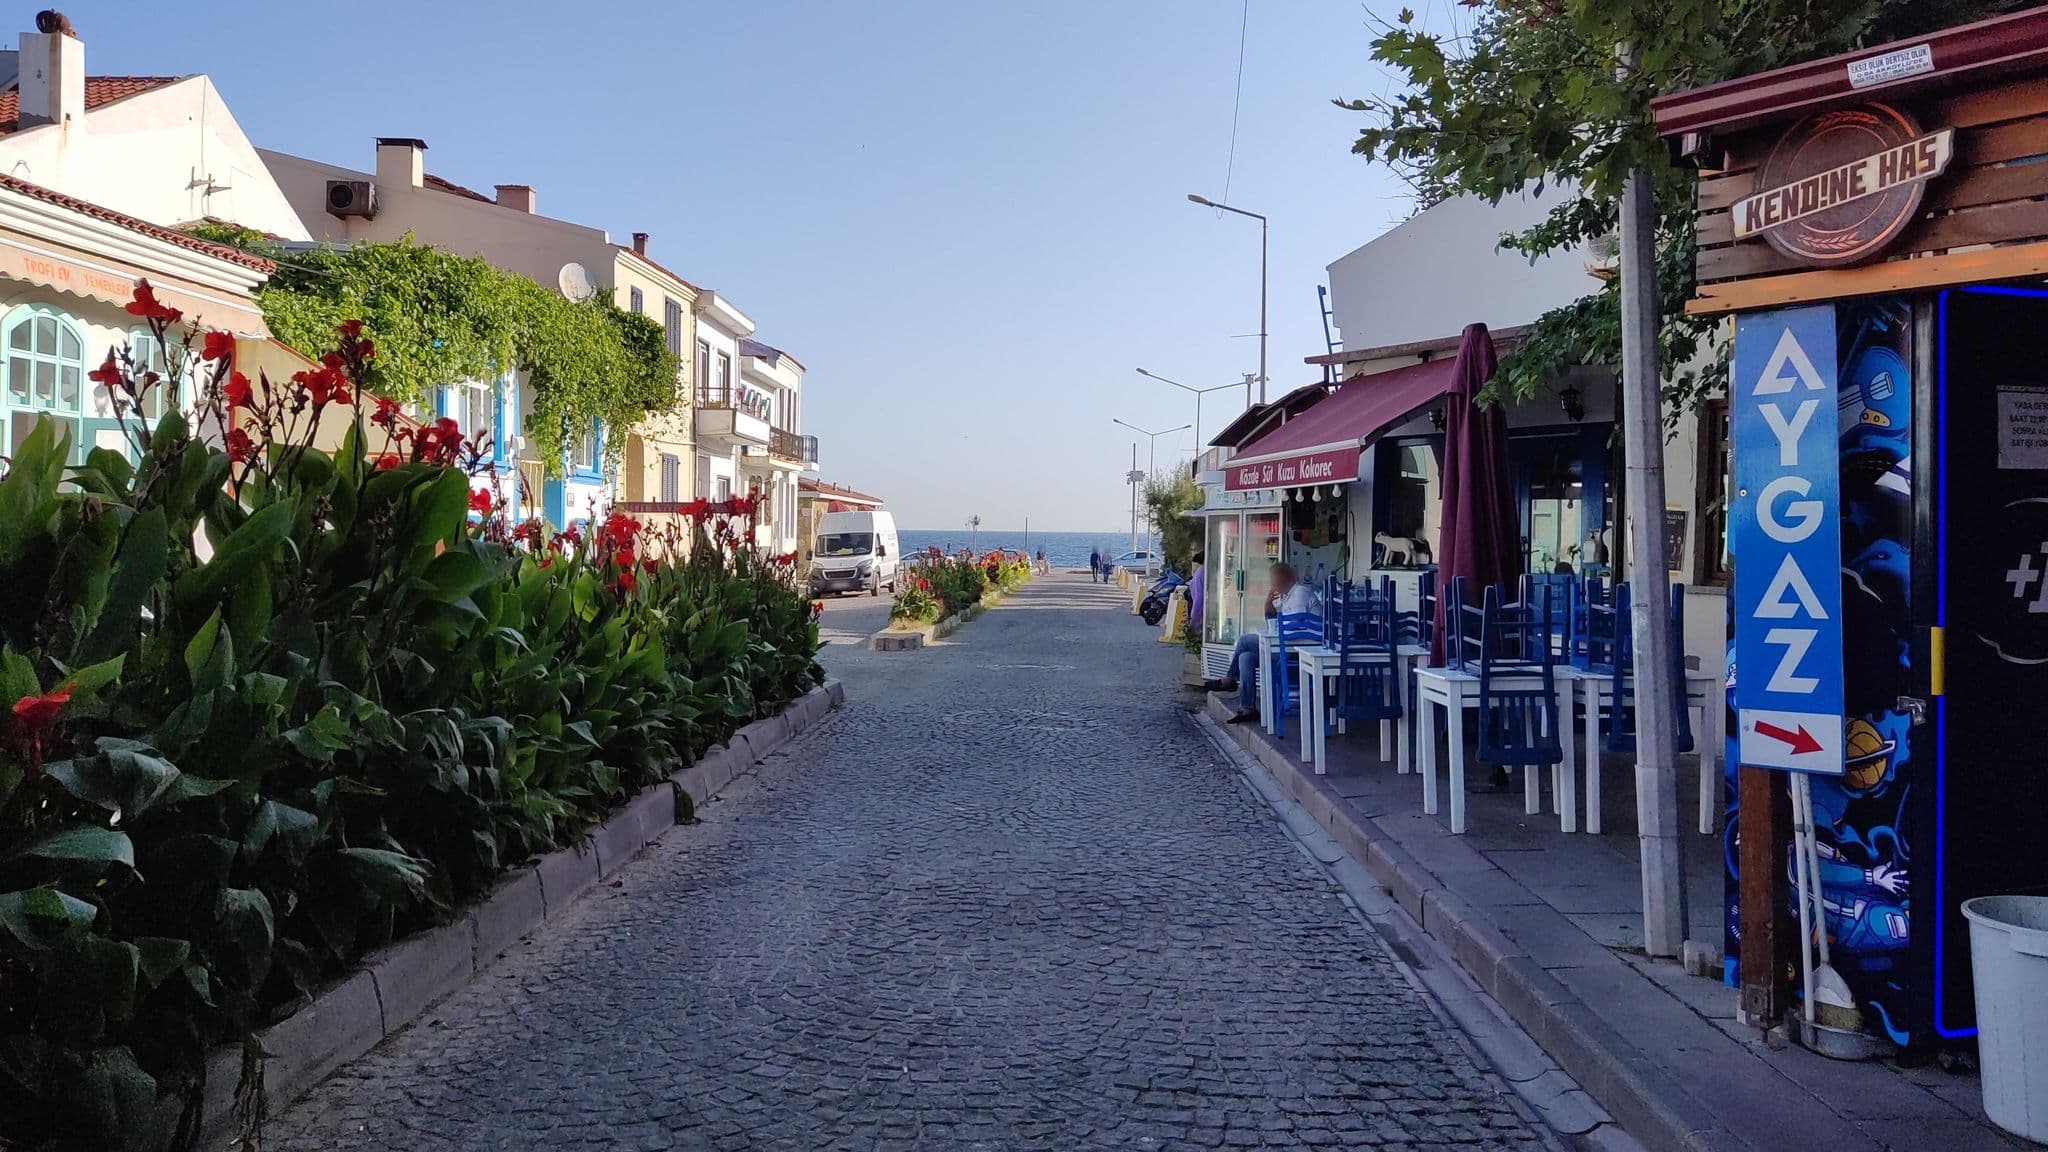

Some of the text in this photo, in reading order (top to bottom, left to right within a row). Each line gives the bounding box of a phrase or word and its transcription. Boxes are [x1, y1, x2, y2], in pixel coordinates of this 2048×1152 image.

[1879, 137, 1938, 188] HAS
[58, 266, 71, 281] EV
[1262, 465, 1274, 483] Süt
[1277, 463, 1296, 482] Kuzu
[1752, 326, 1829, 694] AYGAZ
